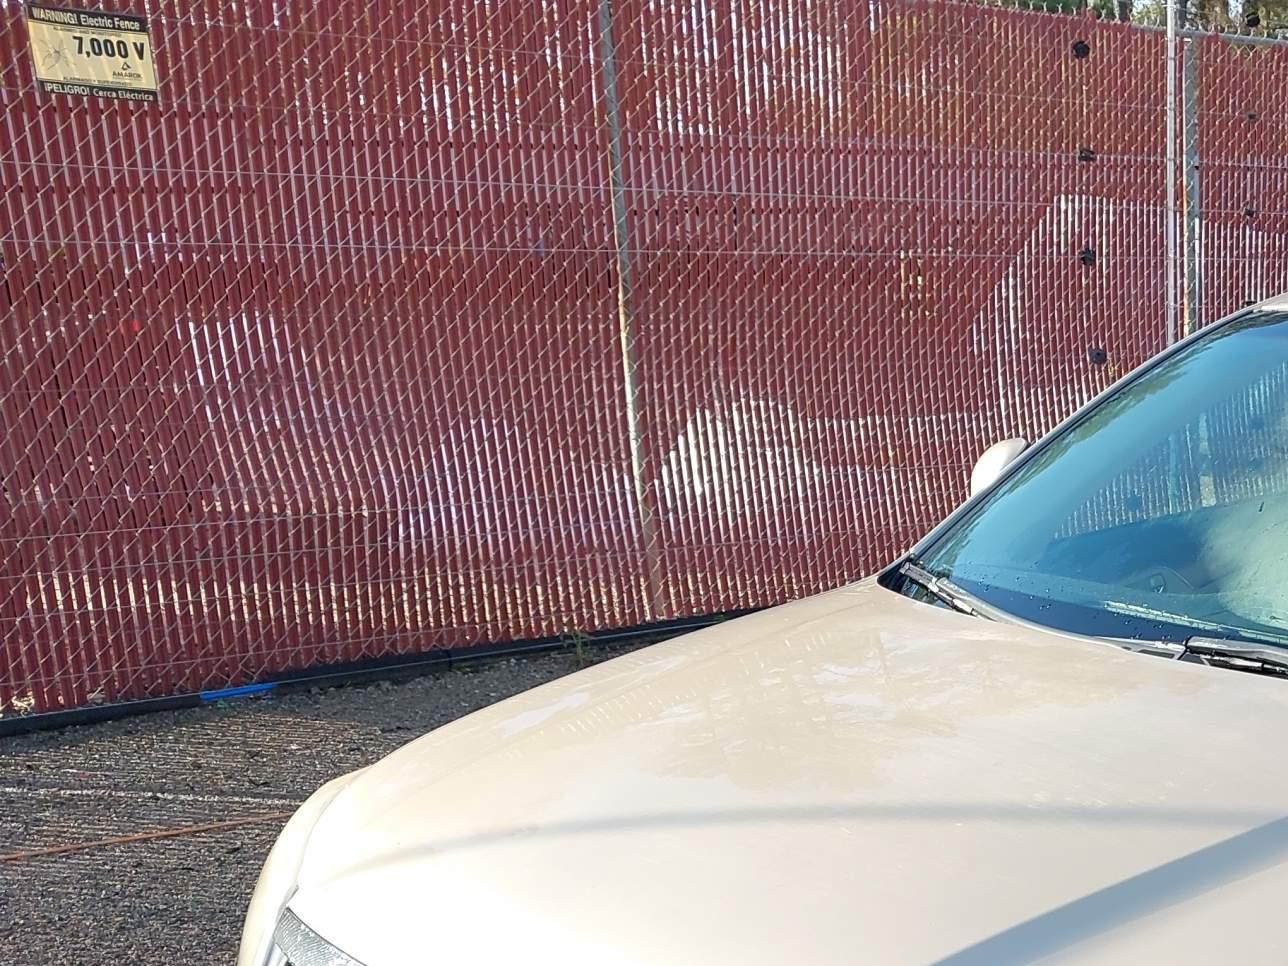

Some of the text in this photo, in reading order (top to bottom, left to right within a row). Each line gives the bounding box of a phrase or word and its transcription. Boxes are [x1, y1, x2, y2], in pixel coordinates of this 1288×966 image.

[32, 7, 140, 31] WARNING! Electric Fence
[72, 36, 145, 60] 7,000 V
[93, 88, 117, 99] Cerca
[119, 90, 154, 102] Eléctrica
